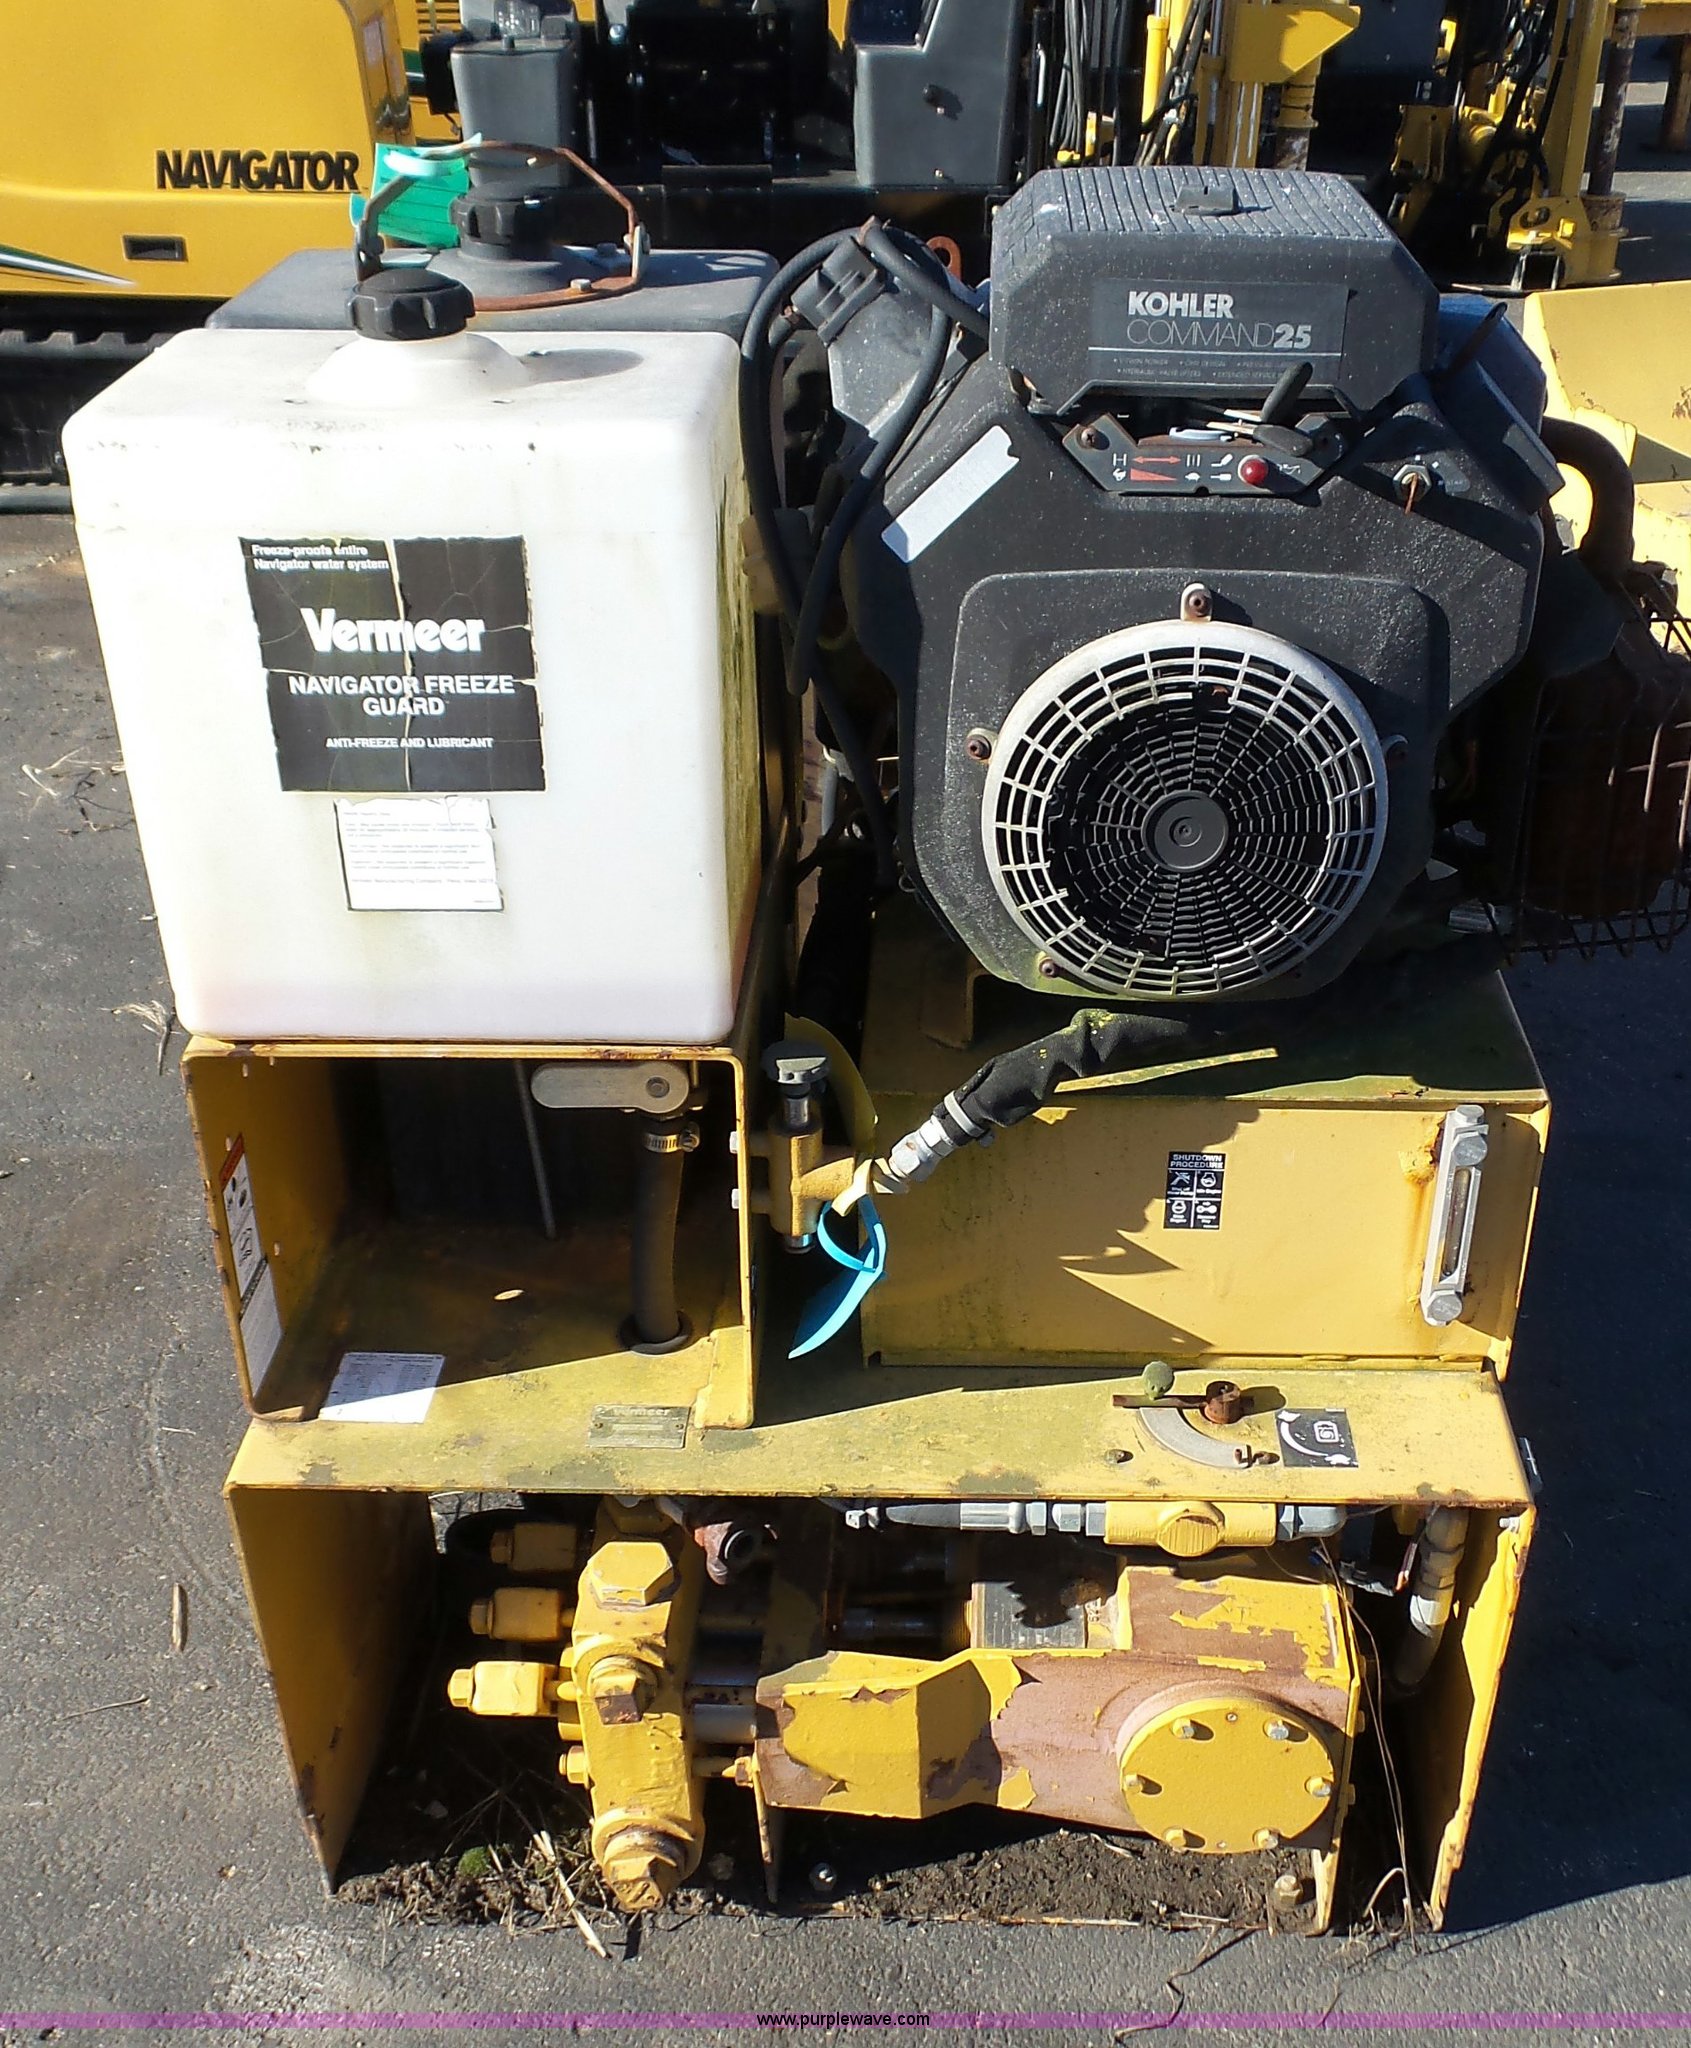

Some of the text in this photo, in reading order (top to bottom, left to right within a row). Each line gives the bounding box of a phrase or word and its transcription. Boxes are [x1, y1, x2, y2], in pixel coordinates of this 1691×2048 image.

[156, 149, 360, 191] NAVIGATOR
[1127, 290, 1234, 319] KOHLER
[251, 544, 368, 558] Freeze-proofs entire
[253, 558, 390, 572] Navigator water system
[300, 607, 486, 653] Vermeer
[288, 674, 516, 696] NAVIGATOR FREEZE
[362, 697, 446, 716] GUARD
[326, 737, 494, 749] ANTI-FREEZE AND LUBRICANT
[1170, 1161, 1224, 1169] PROCEDURE
